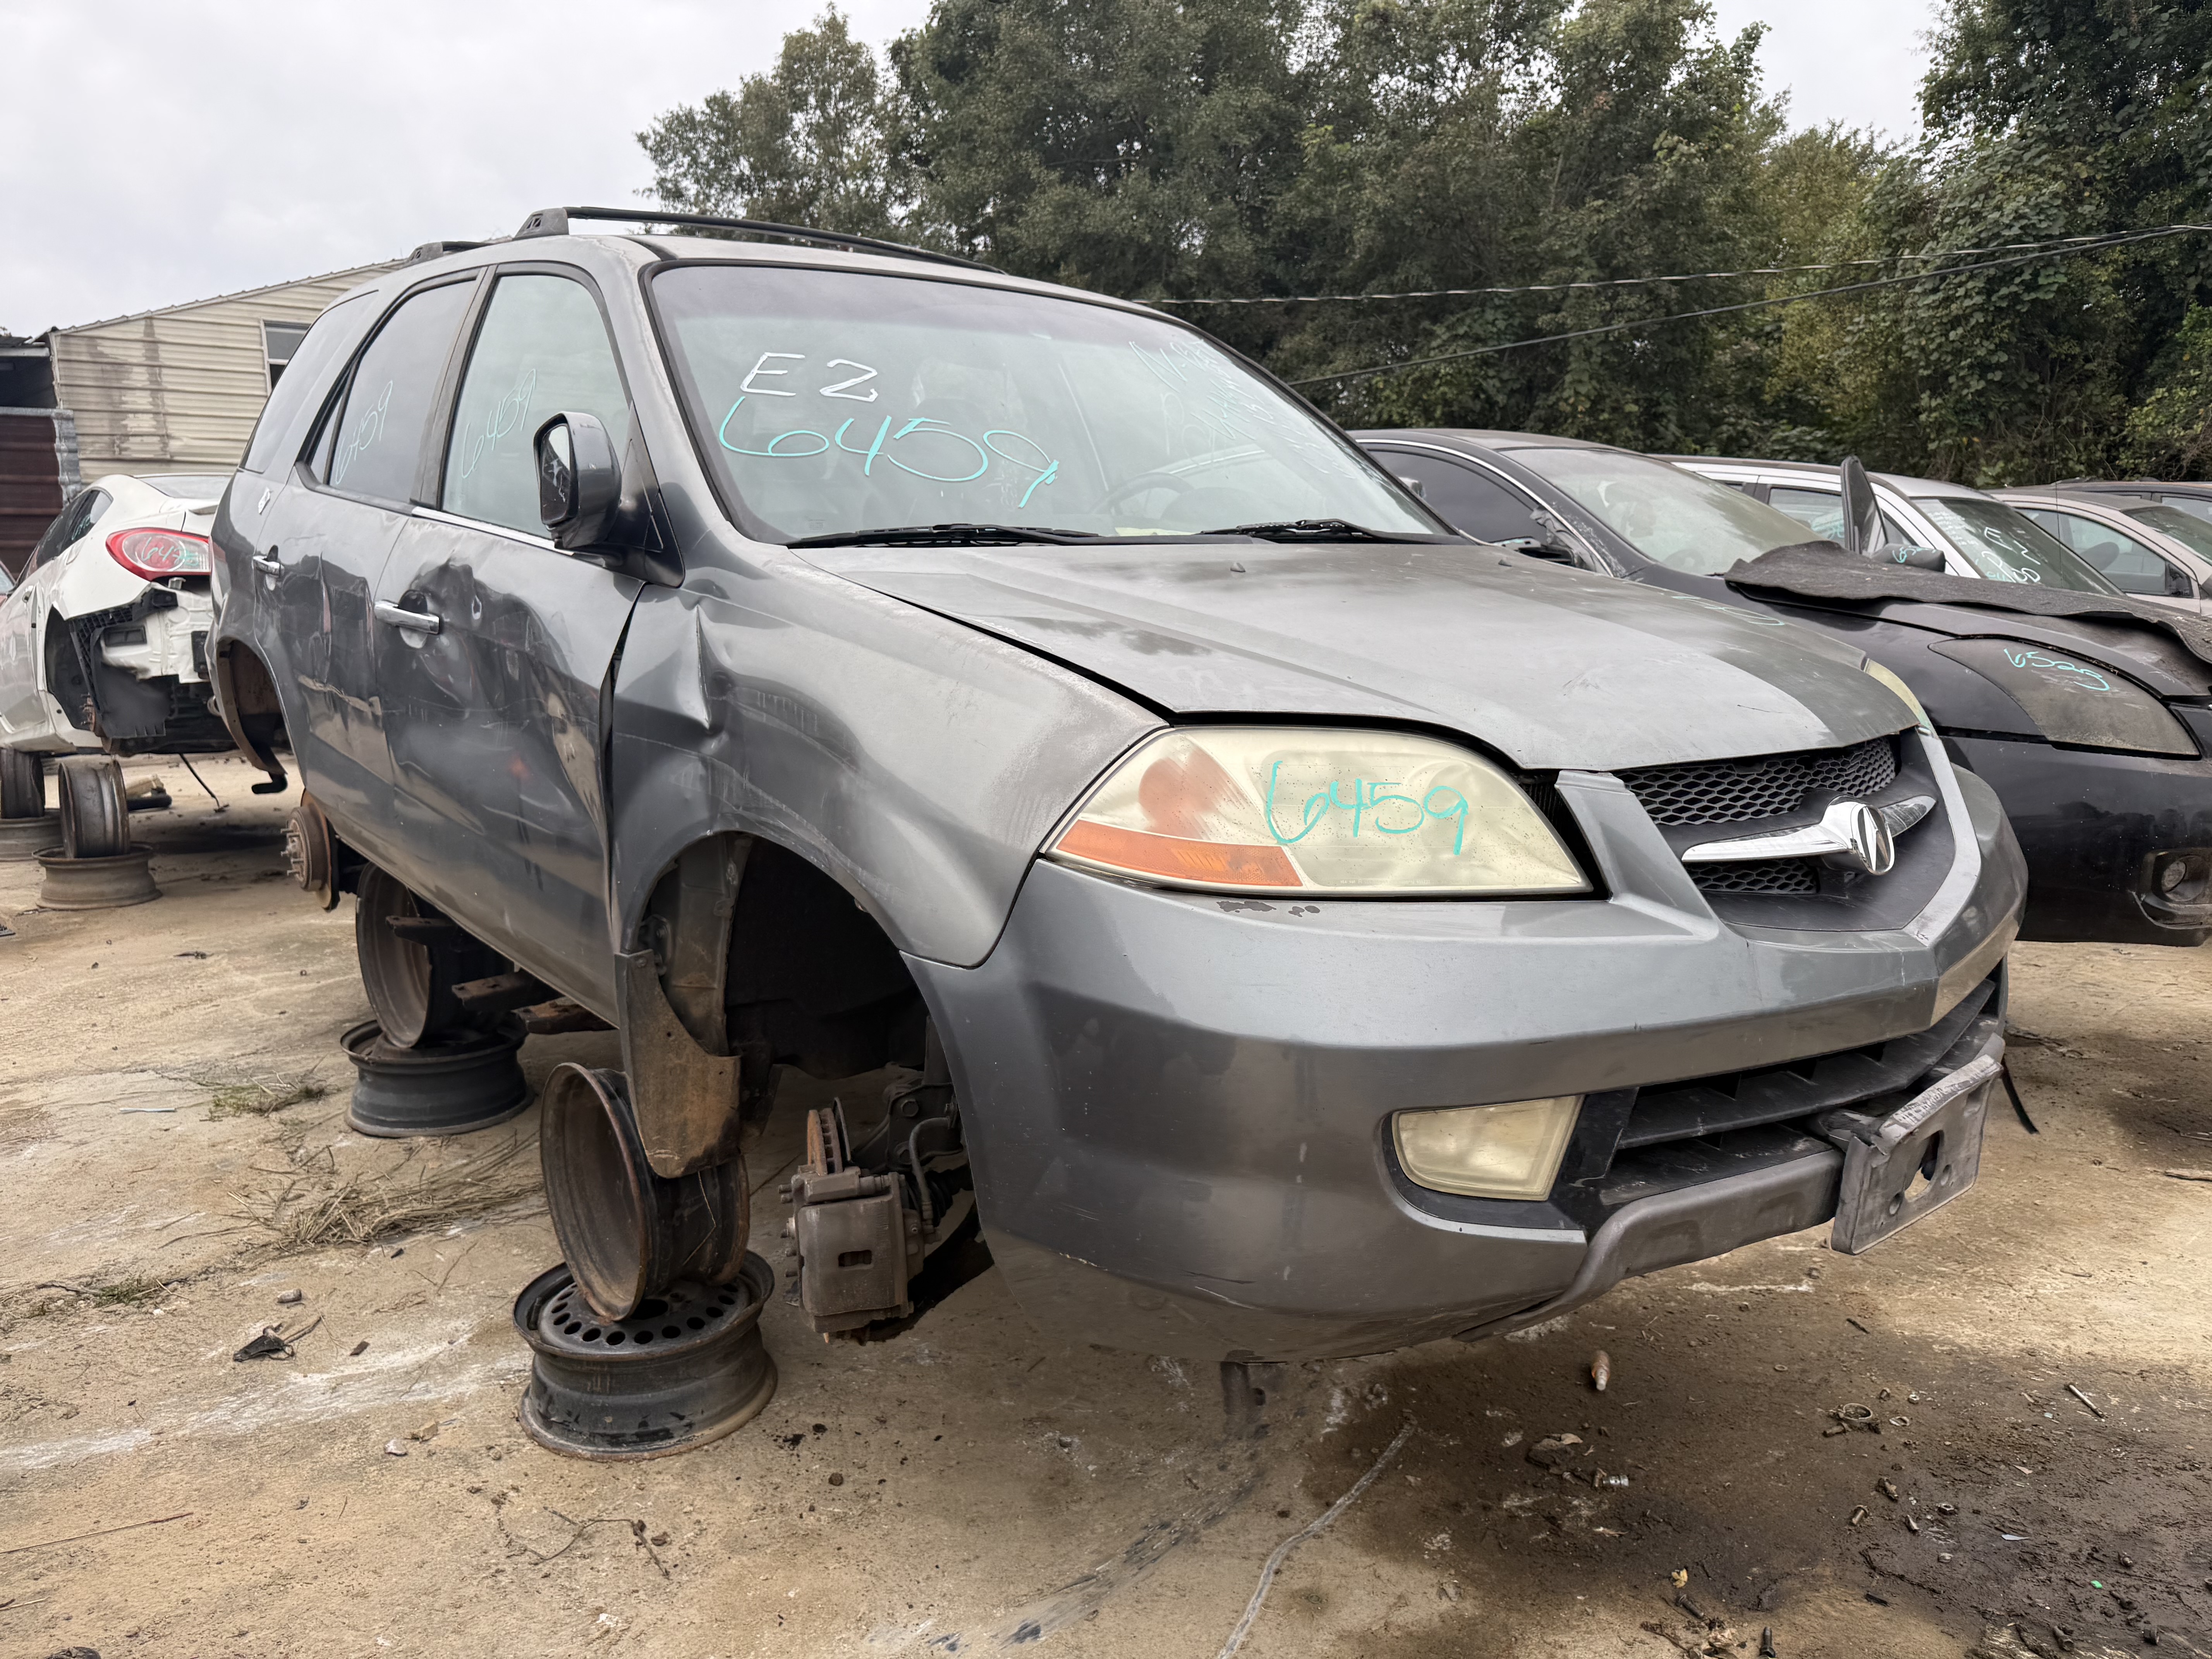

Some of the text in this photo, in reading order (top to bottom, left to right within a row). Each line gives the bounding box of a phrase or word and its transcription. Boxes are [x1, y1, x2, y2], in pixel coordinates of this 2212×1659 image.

[335, 380, 393, 485] 6459
[461, 368, 536, 479] 6459
[719, 396, 1059, 508] 6459
[2004, 648, 2110, 691] 6523
[1266, 761, 1469, 855] 6459
